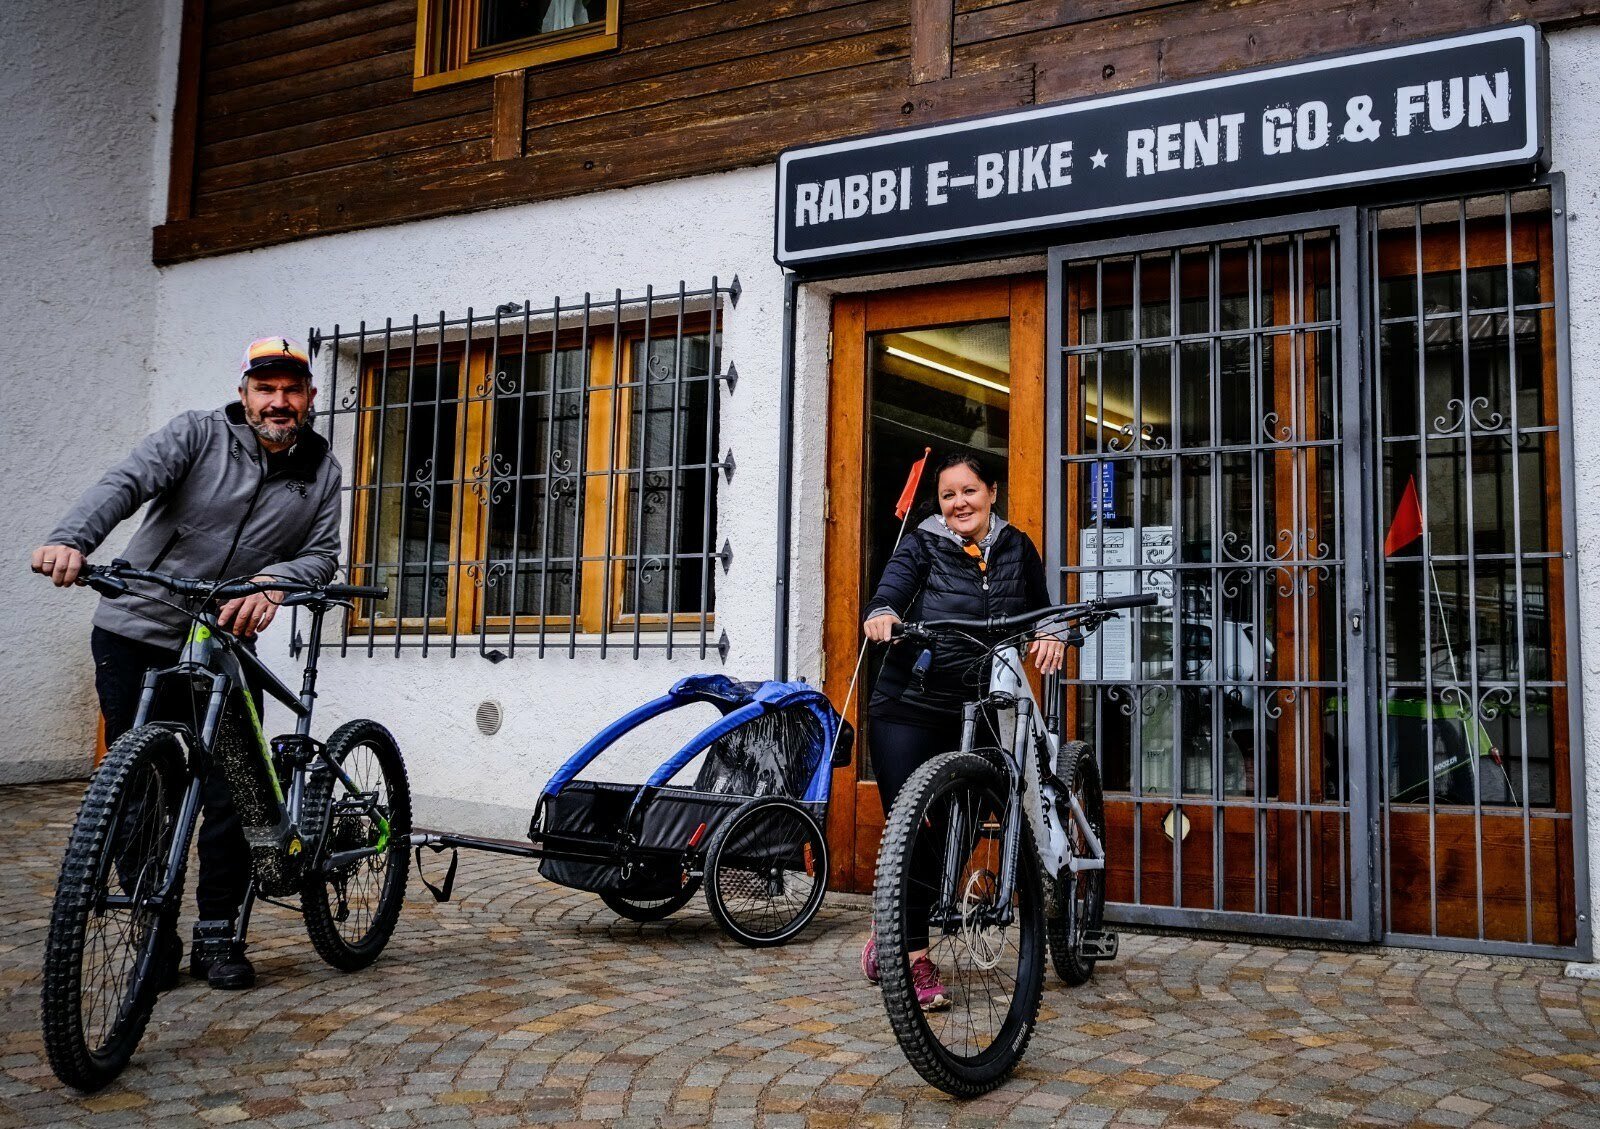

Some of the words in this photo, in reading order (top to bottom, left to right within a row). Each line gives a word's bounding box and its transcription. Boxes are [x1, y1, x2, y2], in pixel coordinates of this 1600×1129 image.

[795, 167, 912, 228] RABBI
[926, 141, 1073, 206] E-BIKE
[1125, 112, 1246, 178] RENT
[1262, 100, 1333, 156] GO
[1336, 95, 1382, 143] &
[1394, 69, 1512, 138] FUN
